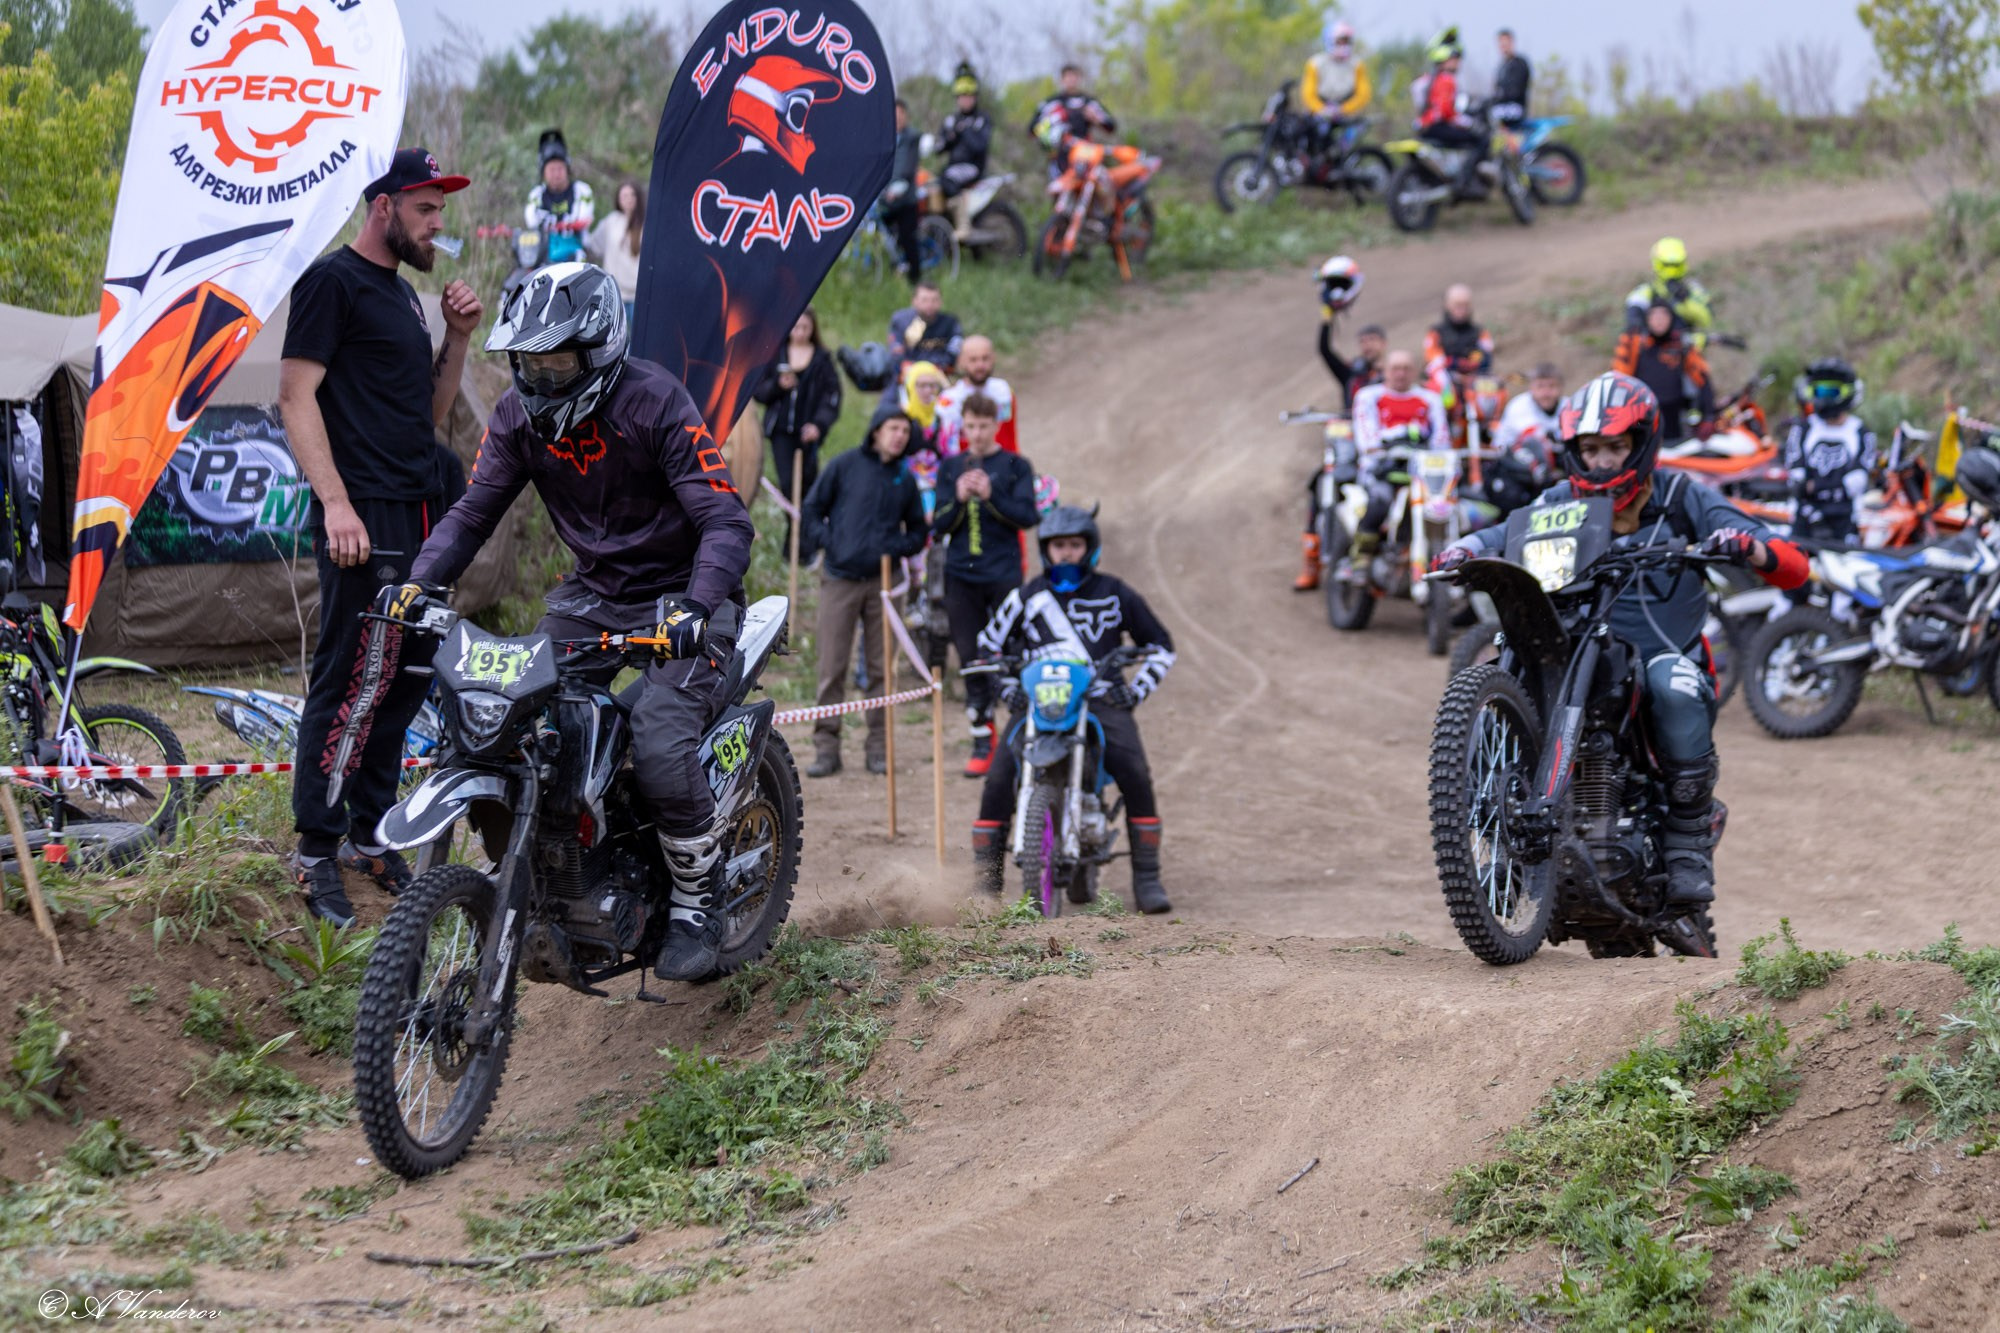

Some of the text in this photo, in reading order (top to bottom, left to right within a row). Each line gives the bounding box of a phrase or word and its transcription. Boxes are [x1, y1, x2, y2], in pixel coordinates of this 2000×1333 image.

[191, 0, 242, 48] СТА
[691, 7, 877, 100] ENDURO
[160, 75, 382, 113] HYPERCUT
[169, 139, 359, 205] ДЛЯ РЕЗКИ МЕТАЛЛА
[1543, 512, 1568, 528] 10
[478, 641, 525, 653] HILL CLIMB
[479, 651, 511, 674] 95
[483, 672, 503, 683] LITE
[722, 736, 741, 764] 95
